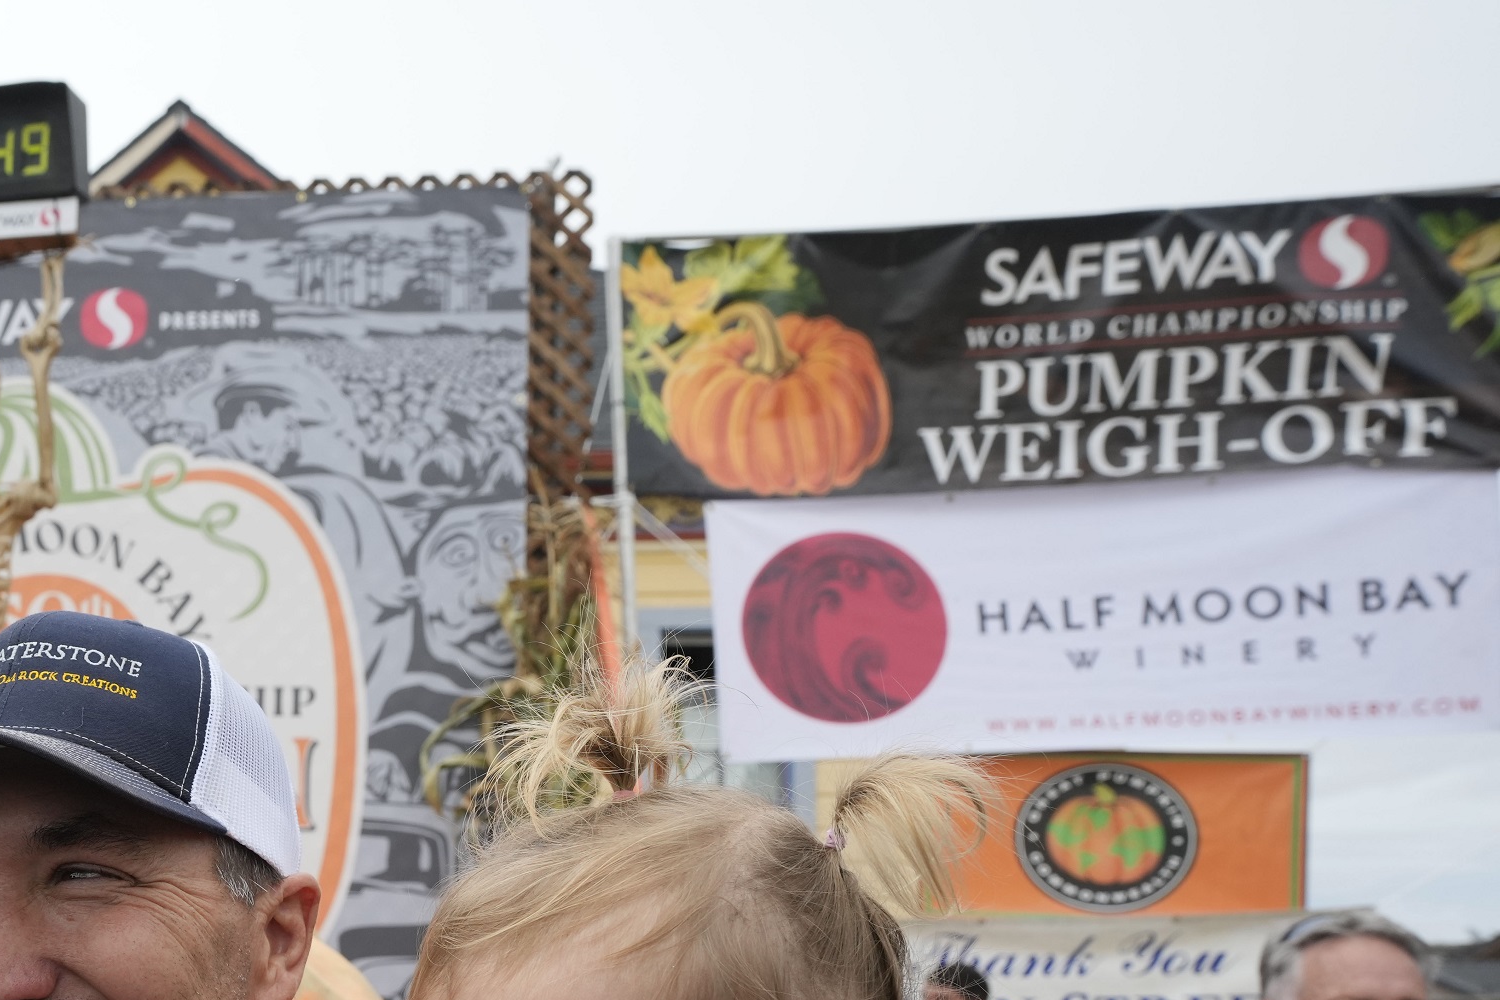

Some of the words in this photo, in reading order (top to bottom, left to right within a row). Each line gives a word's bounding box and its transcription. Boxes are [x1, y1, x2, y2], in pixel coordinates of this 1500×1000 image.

[981, 229, 1291, 307] SAFEWAY
[158, 309, 260, 332] PRESENTS
[964, 317, 1096, 351] WORLD
[1106, 298, 1408, 342] CHAMPIONSHIP
[975, 332, 1396, 420] PUMPKIN
[918, 397, 1458, 485] WEIGH-OFF
[978, 594, 1116, 634] HALF
[1140, 582, 1332, 627] MOON
[1358, 570, 1471, 615] BAY
[1065, 633, 1378, 671] WINERY
[18, 670, 58, 681] ROCK
[62, 672, 138, 699] CREATIONS
[1120, 929, 1229, 978] You
